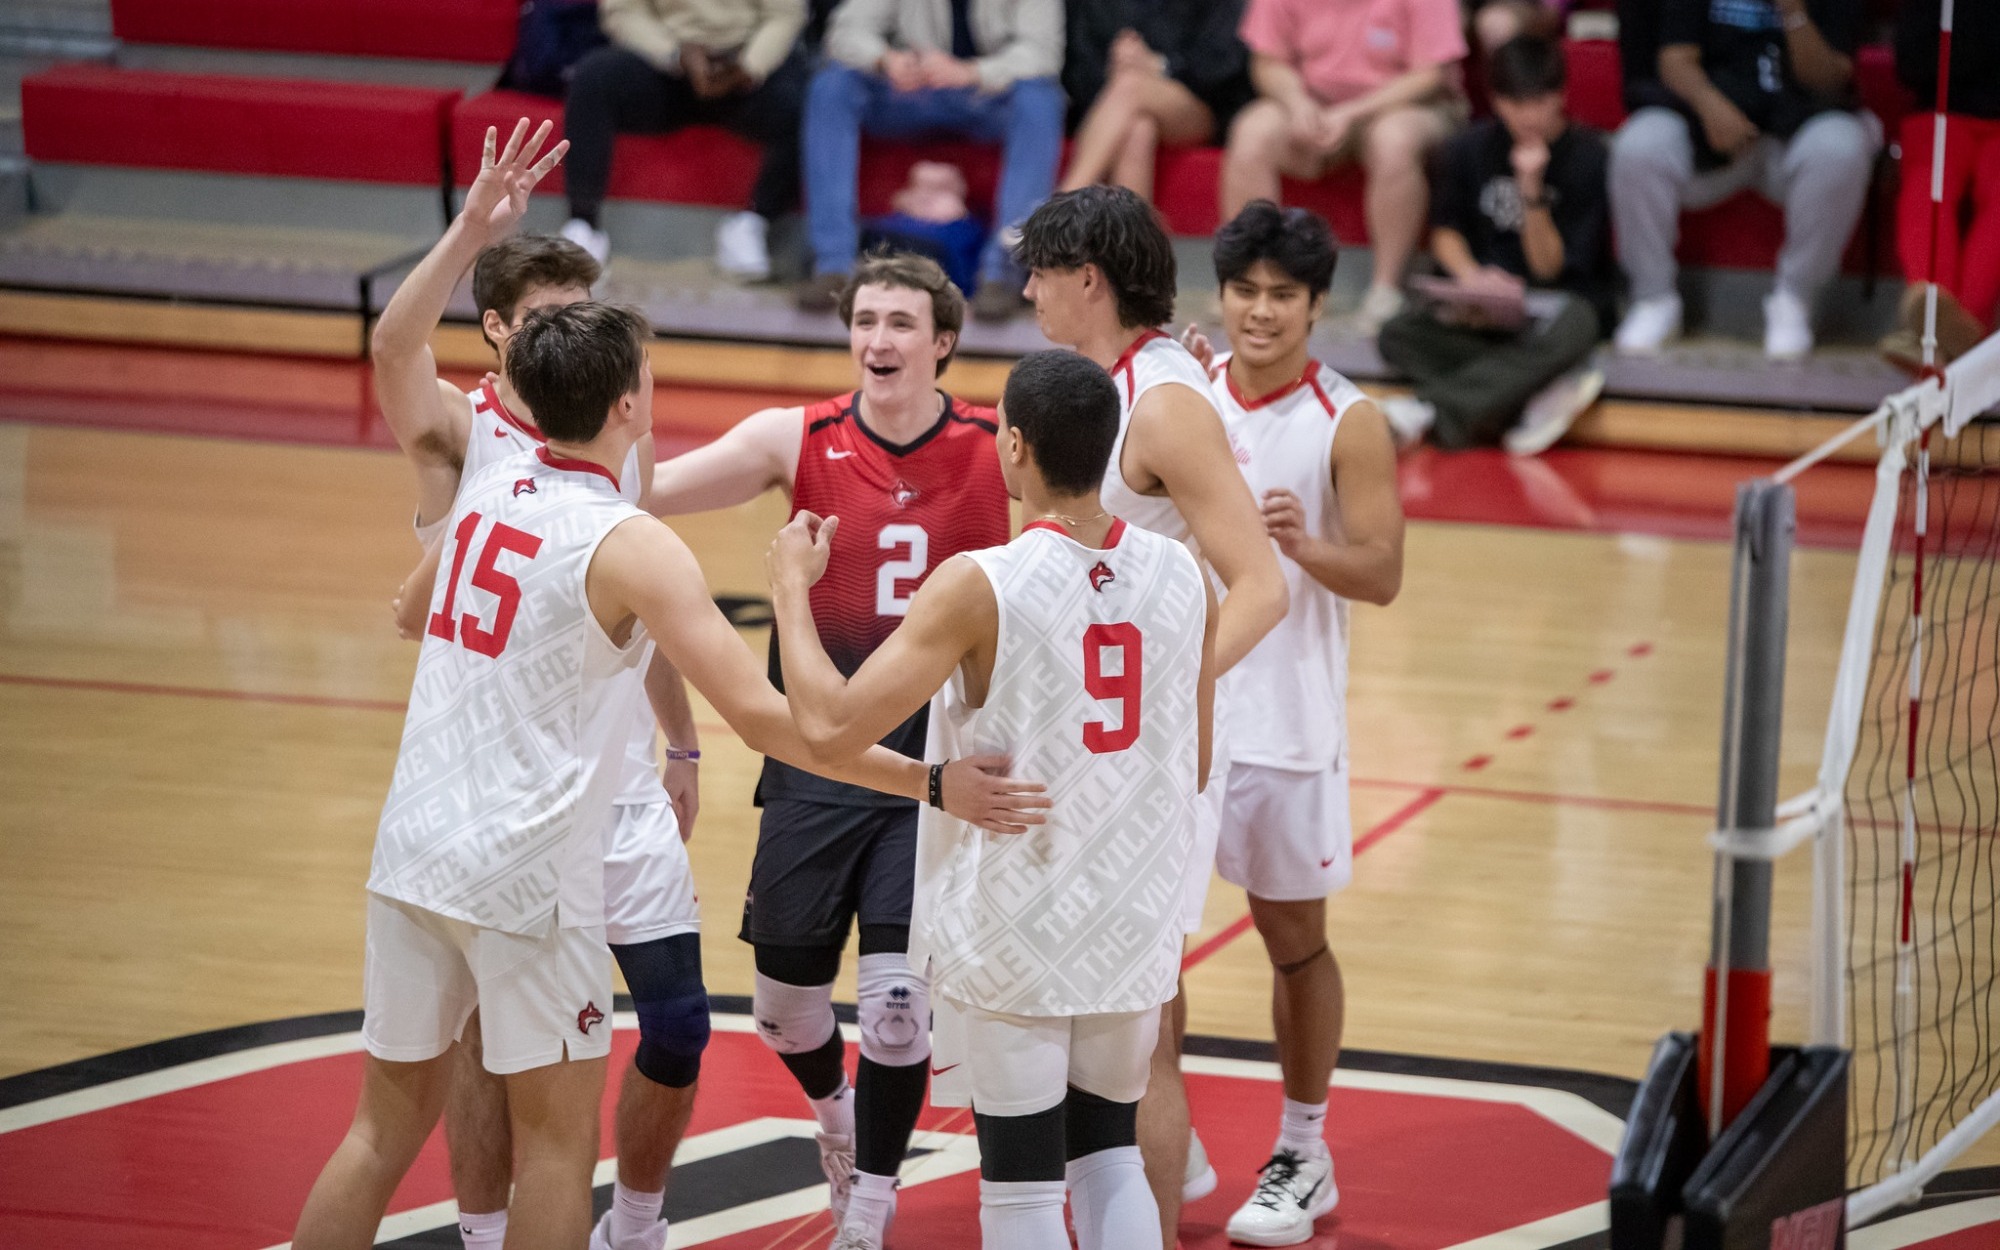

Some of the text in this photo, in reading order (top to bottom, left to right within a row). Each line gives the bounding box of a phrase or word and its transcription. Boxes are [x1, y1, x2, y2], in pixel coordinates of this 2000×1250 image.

[428, 511, 544, 659] 15
[875, 524, 929, 616] 2
[511, 643, 580, 700] THE
[1082, 621, 1143, 754] 9
[1141, 668, 1198, 740] THE
[387, 796, 448, 853] THE
[407, 846, 471, 897] THE
[991, 832, 1064, 898] THE
[1052, 755, 1140, 838] VILLE
[1033, 873, 1103, 944] THE
[1088, 787, 1177, 883] VILLE
[1071, 825, 1194, 982] THE VILLE
